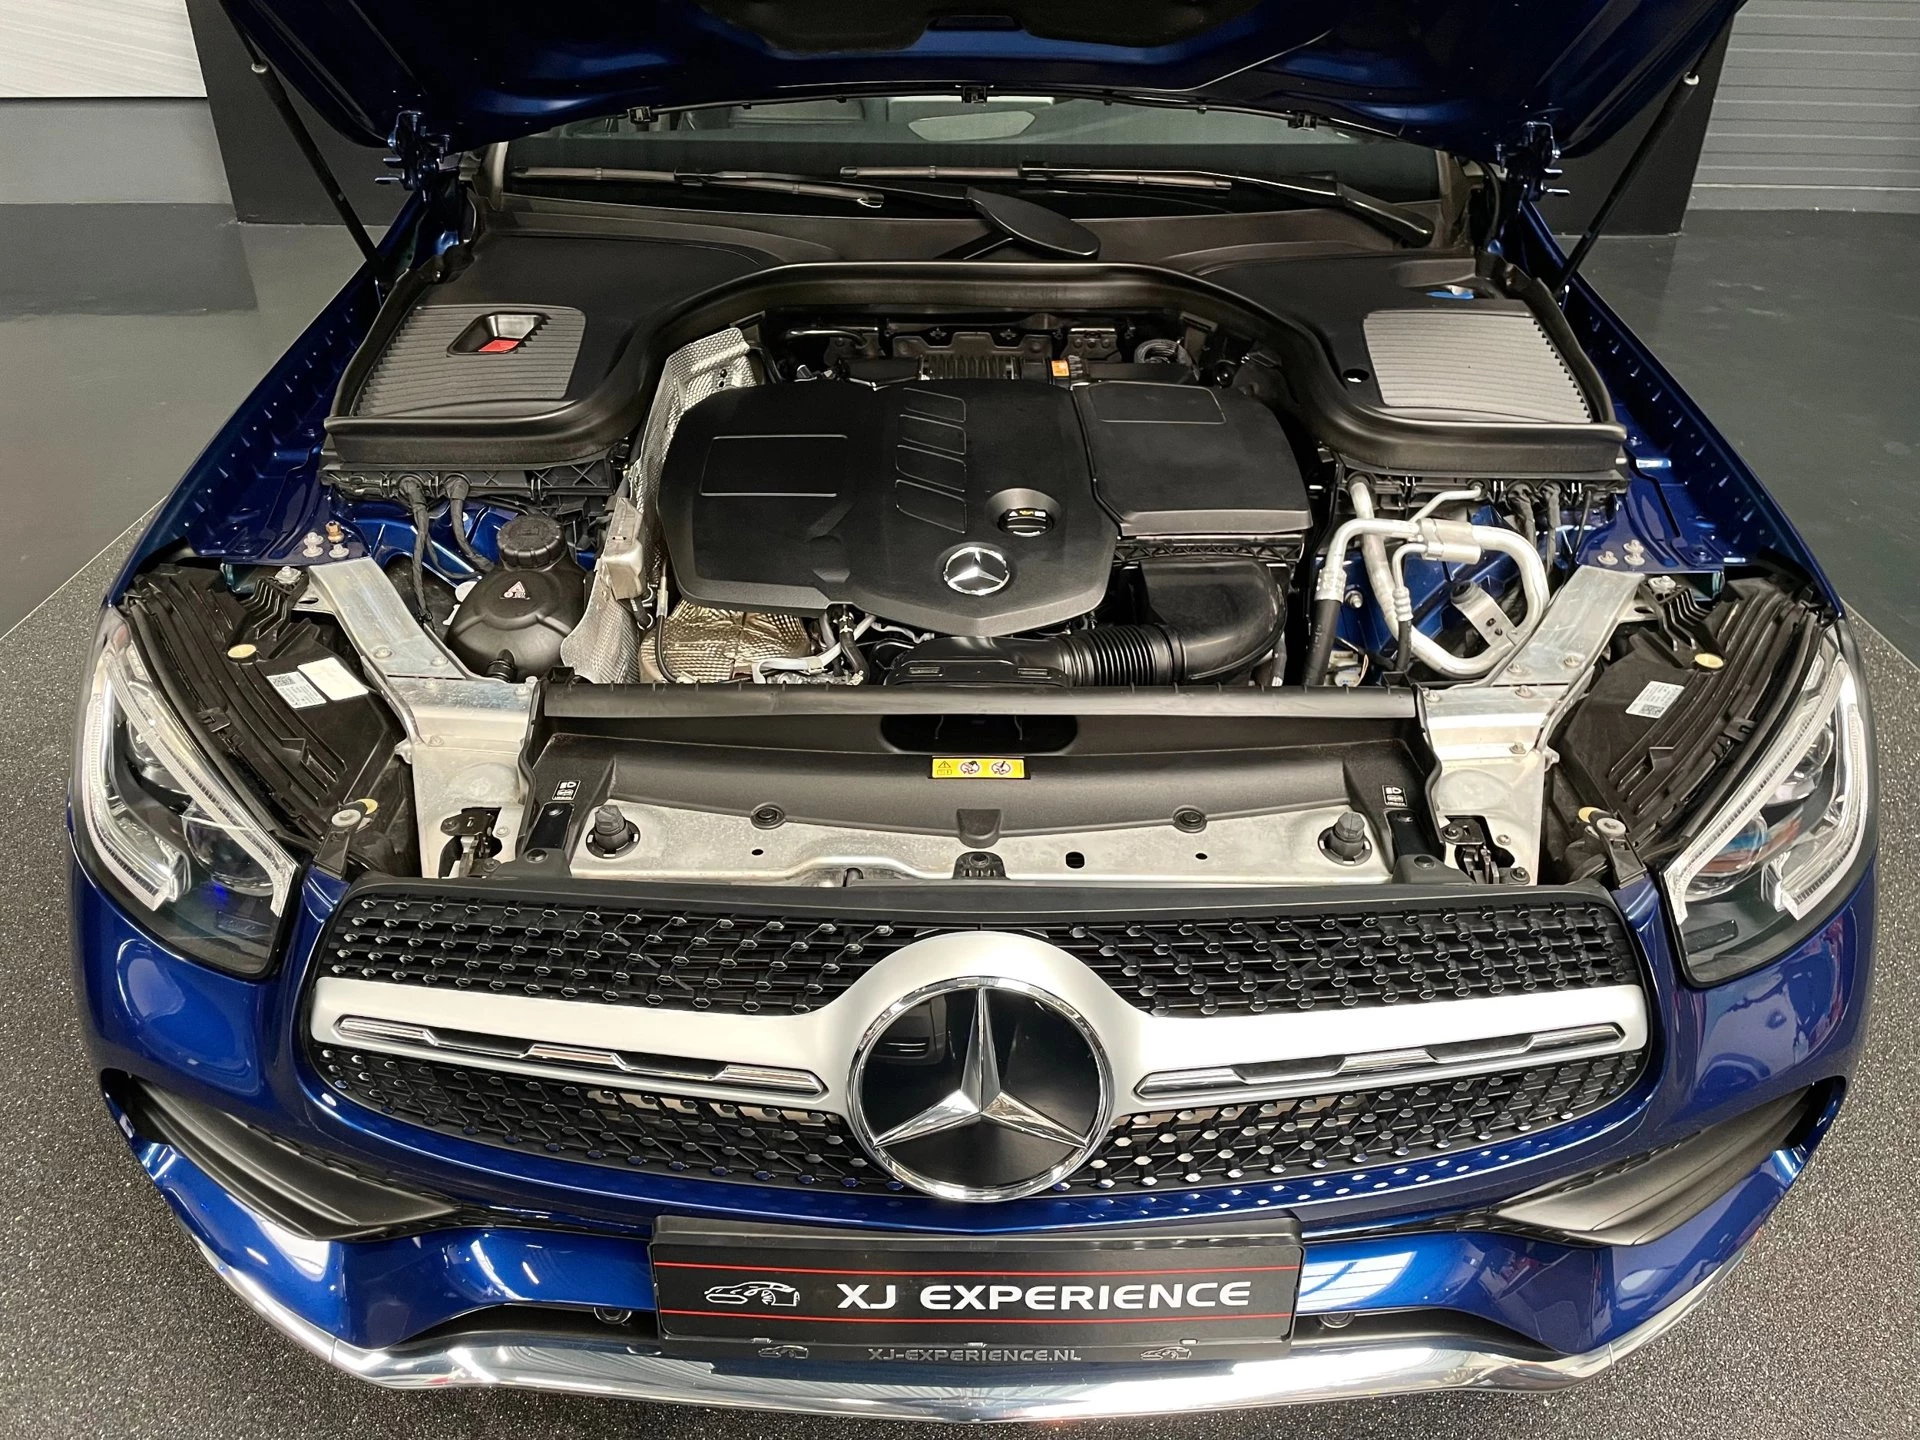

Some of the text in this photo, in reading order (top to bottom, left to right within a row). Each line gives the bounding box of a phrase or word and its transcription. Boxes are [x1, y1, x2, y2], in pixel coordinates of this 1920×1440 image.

[836, 1281, 1252, 1311] XJ EXPERIENCE
[867, 1348, 1082, 1363] XJ-EXPERIENCE.NL
